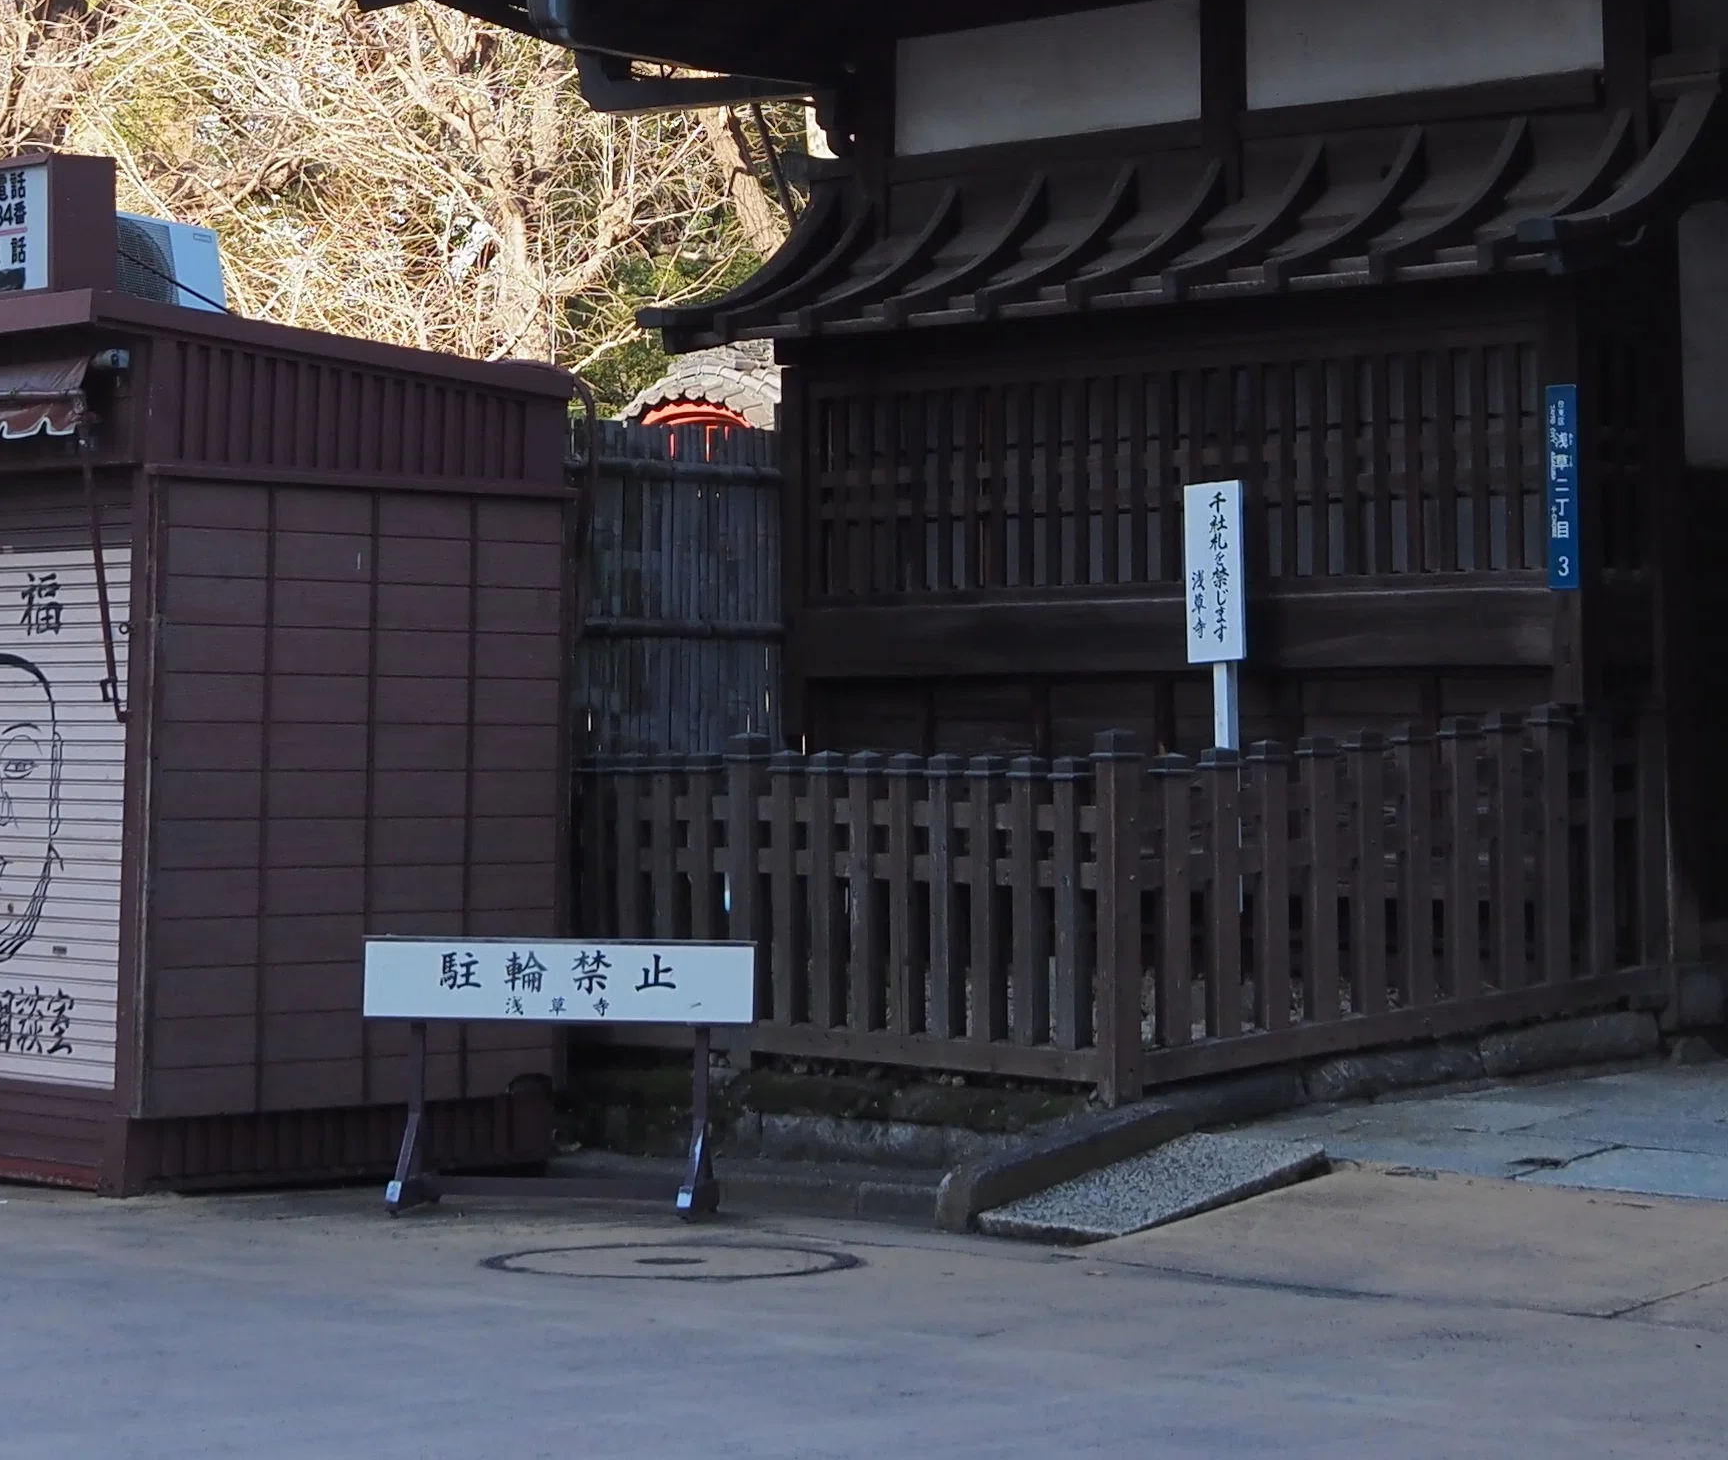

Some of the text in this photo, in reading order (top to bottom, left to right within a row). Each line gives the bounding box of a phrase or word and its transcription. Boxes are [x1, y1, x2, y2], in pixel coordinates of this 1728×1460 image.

[1208, 490, 1229, 643] 千社札を禁じます
[1191, 569, 1208, 640] 浅草寺
[439, 949, 677, 995] 駐輪禁止
[504, 995, 610, 1017] 浅草寺
